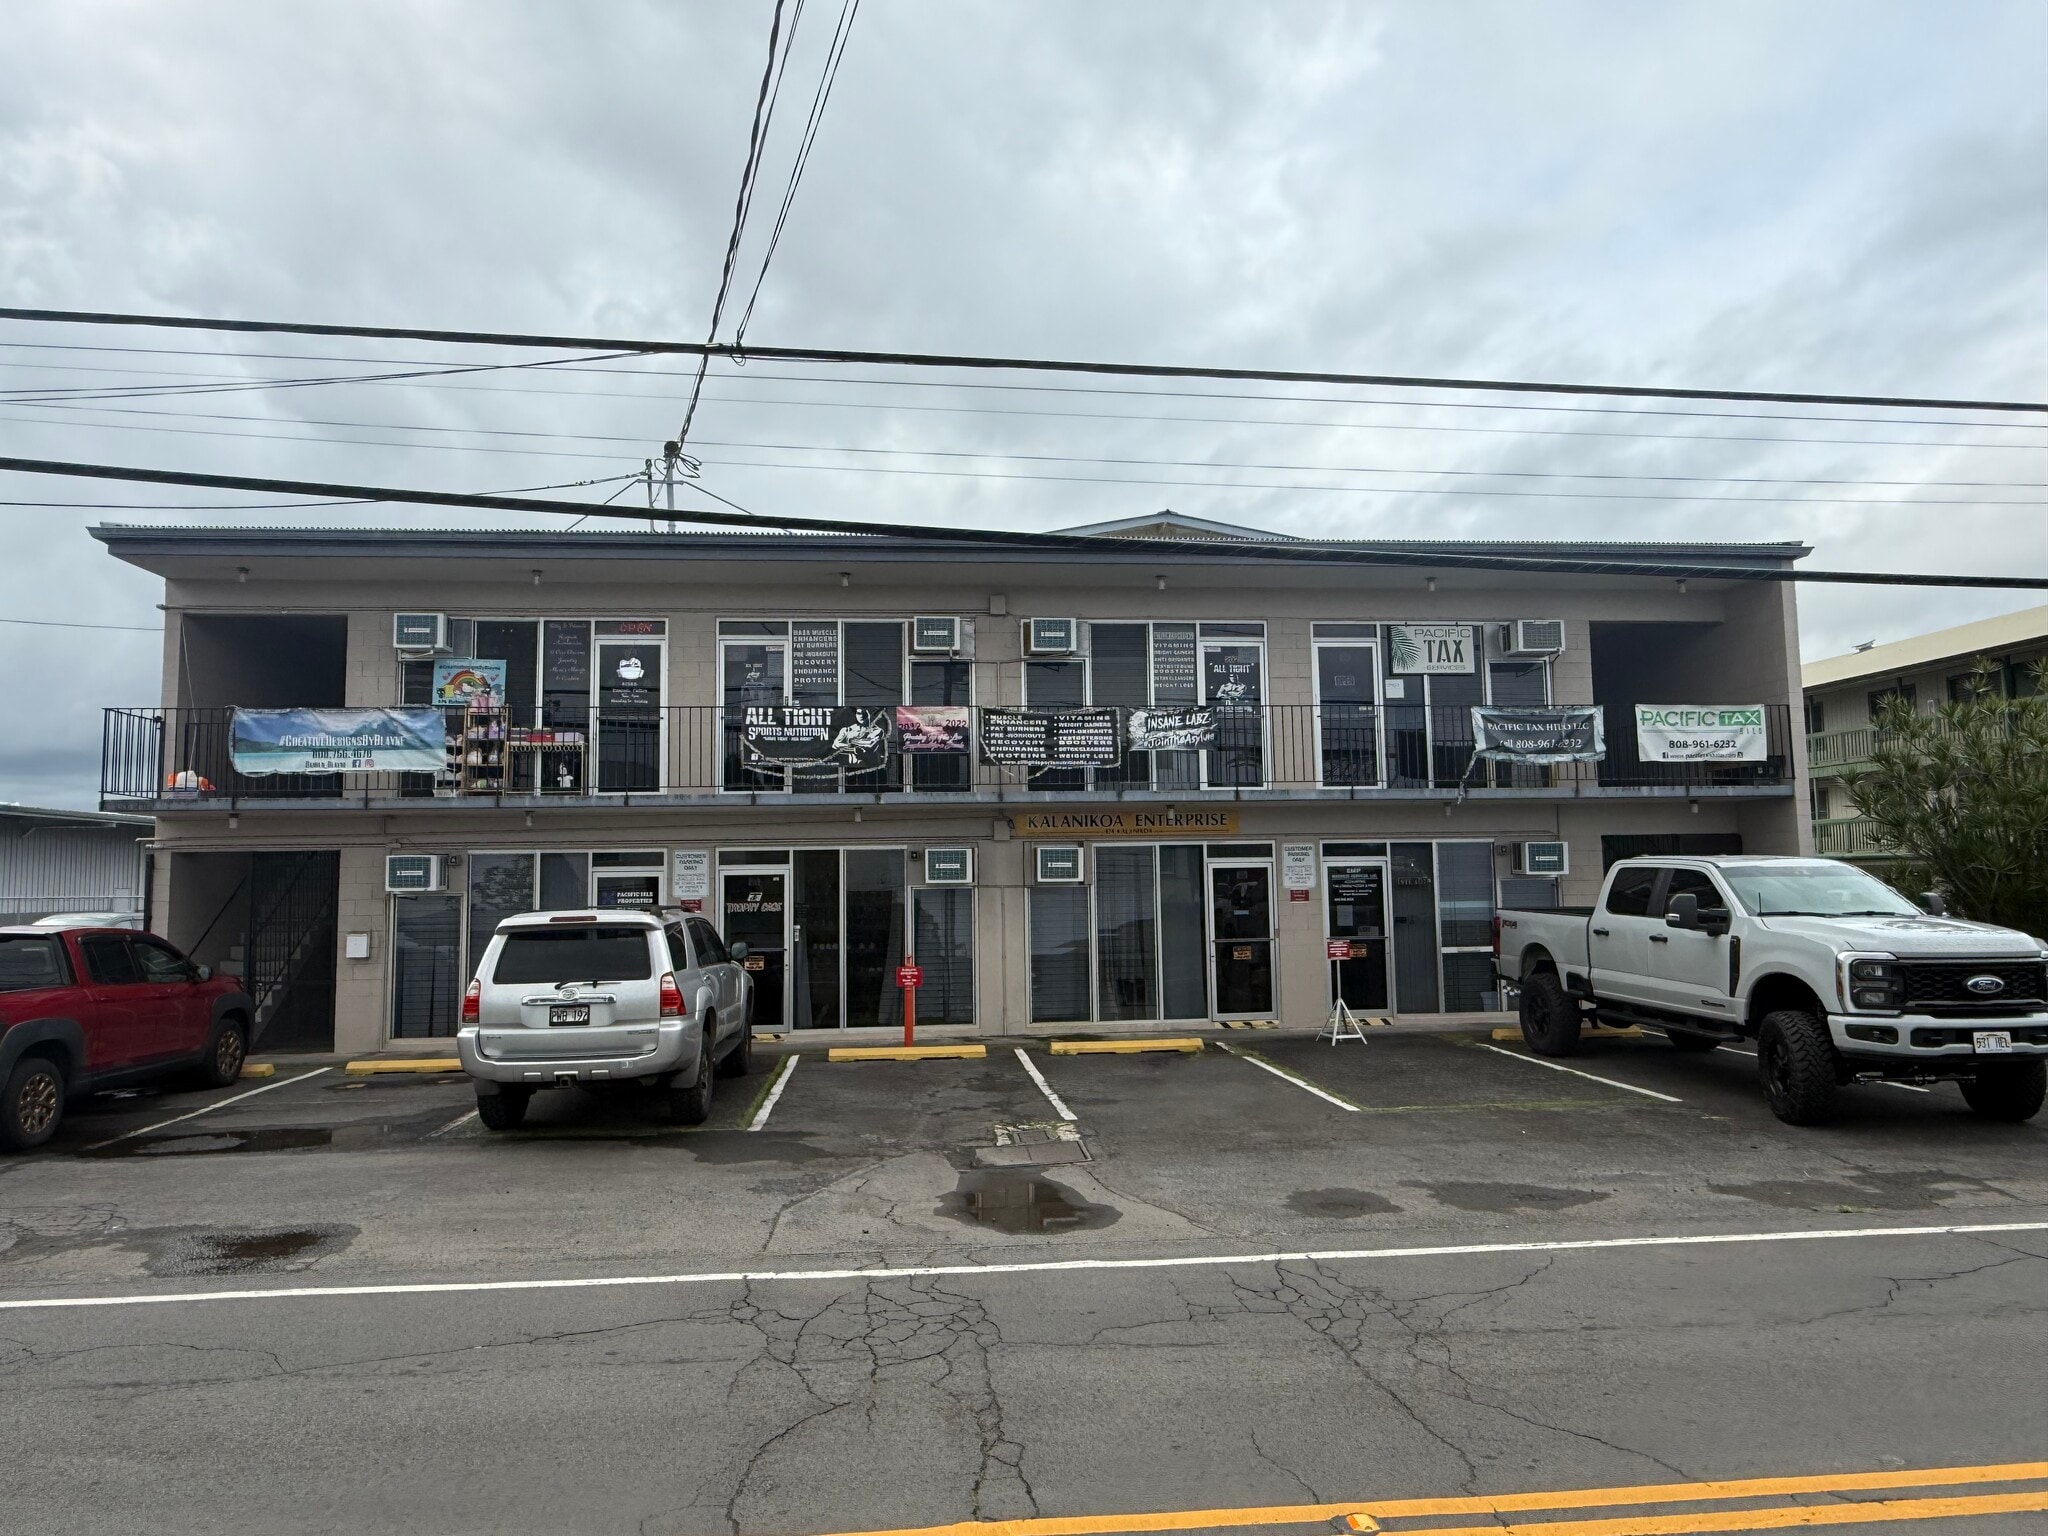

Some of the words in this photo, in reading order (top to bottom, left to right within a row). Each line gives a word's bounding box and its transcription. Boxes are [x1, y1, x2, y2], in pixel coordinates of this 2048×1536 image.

[1414, 628, 1470, 638] PACIFIC
[1423, 640, 1464, 663] TAX
[1213, 664, 1226, 673] ALL
[1229, 664, 1250, 673] TIGHT
[745, 707, 776, 725] ALL
[782, 707, 834, 725] TIGHT
[1640, 710, 1715, 726] PACIFIC
[1720, 711, 1760, 725] TAX
[946, 719, 967, 727] 2022
[1147, 714, 1184, 731] INSANE
[1487, 722, 1524, 731] PACIFIC
[1524, 723, 1545, 731] TAX
[1546, 722, 1571, 731] HILO
[1573, 722, 1590, 730] LLC
[748, 727, 782, 740] SPORTS
[783, 727, 828, 740] NUTRITION
[1668, 740, 1737, 749] 808-961-6232
[1028, 814, 1124, 828] KALANIKOA
[1135, 813, 1228, 827] ENTERPRISE
[726, 902, 760, 913] TROPHY
[761, 902, 783, 912] CASE
[1977, 980, 1996, 990] Ford
